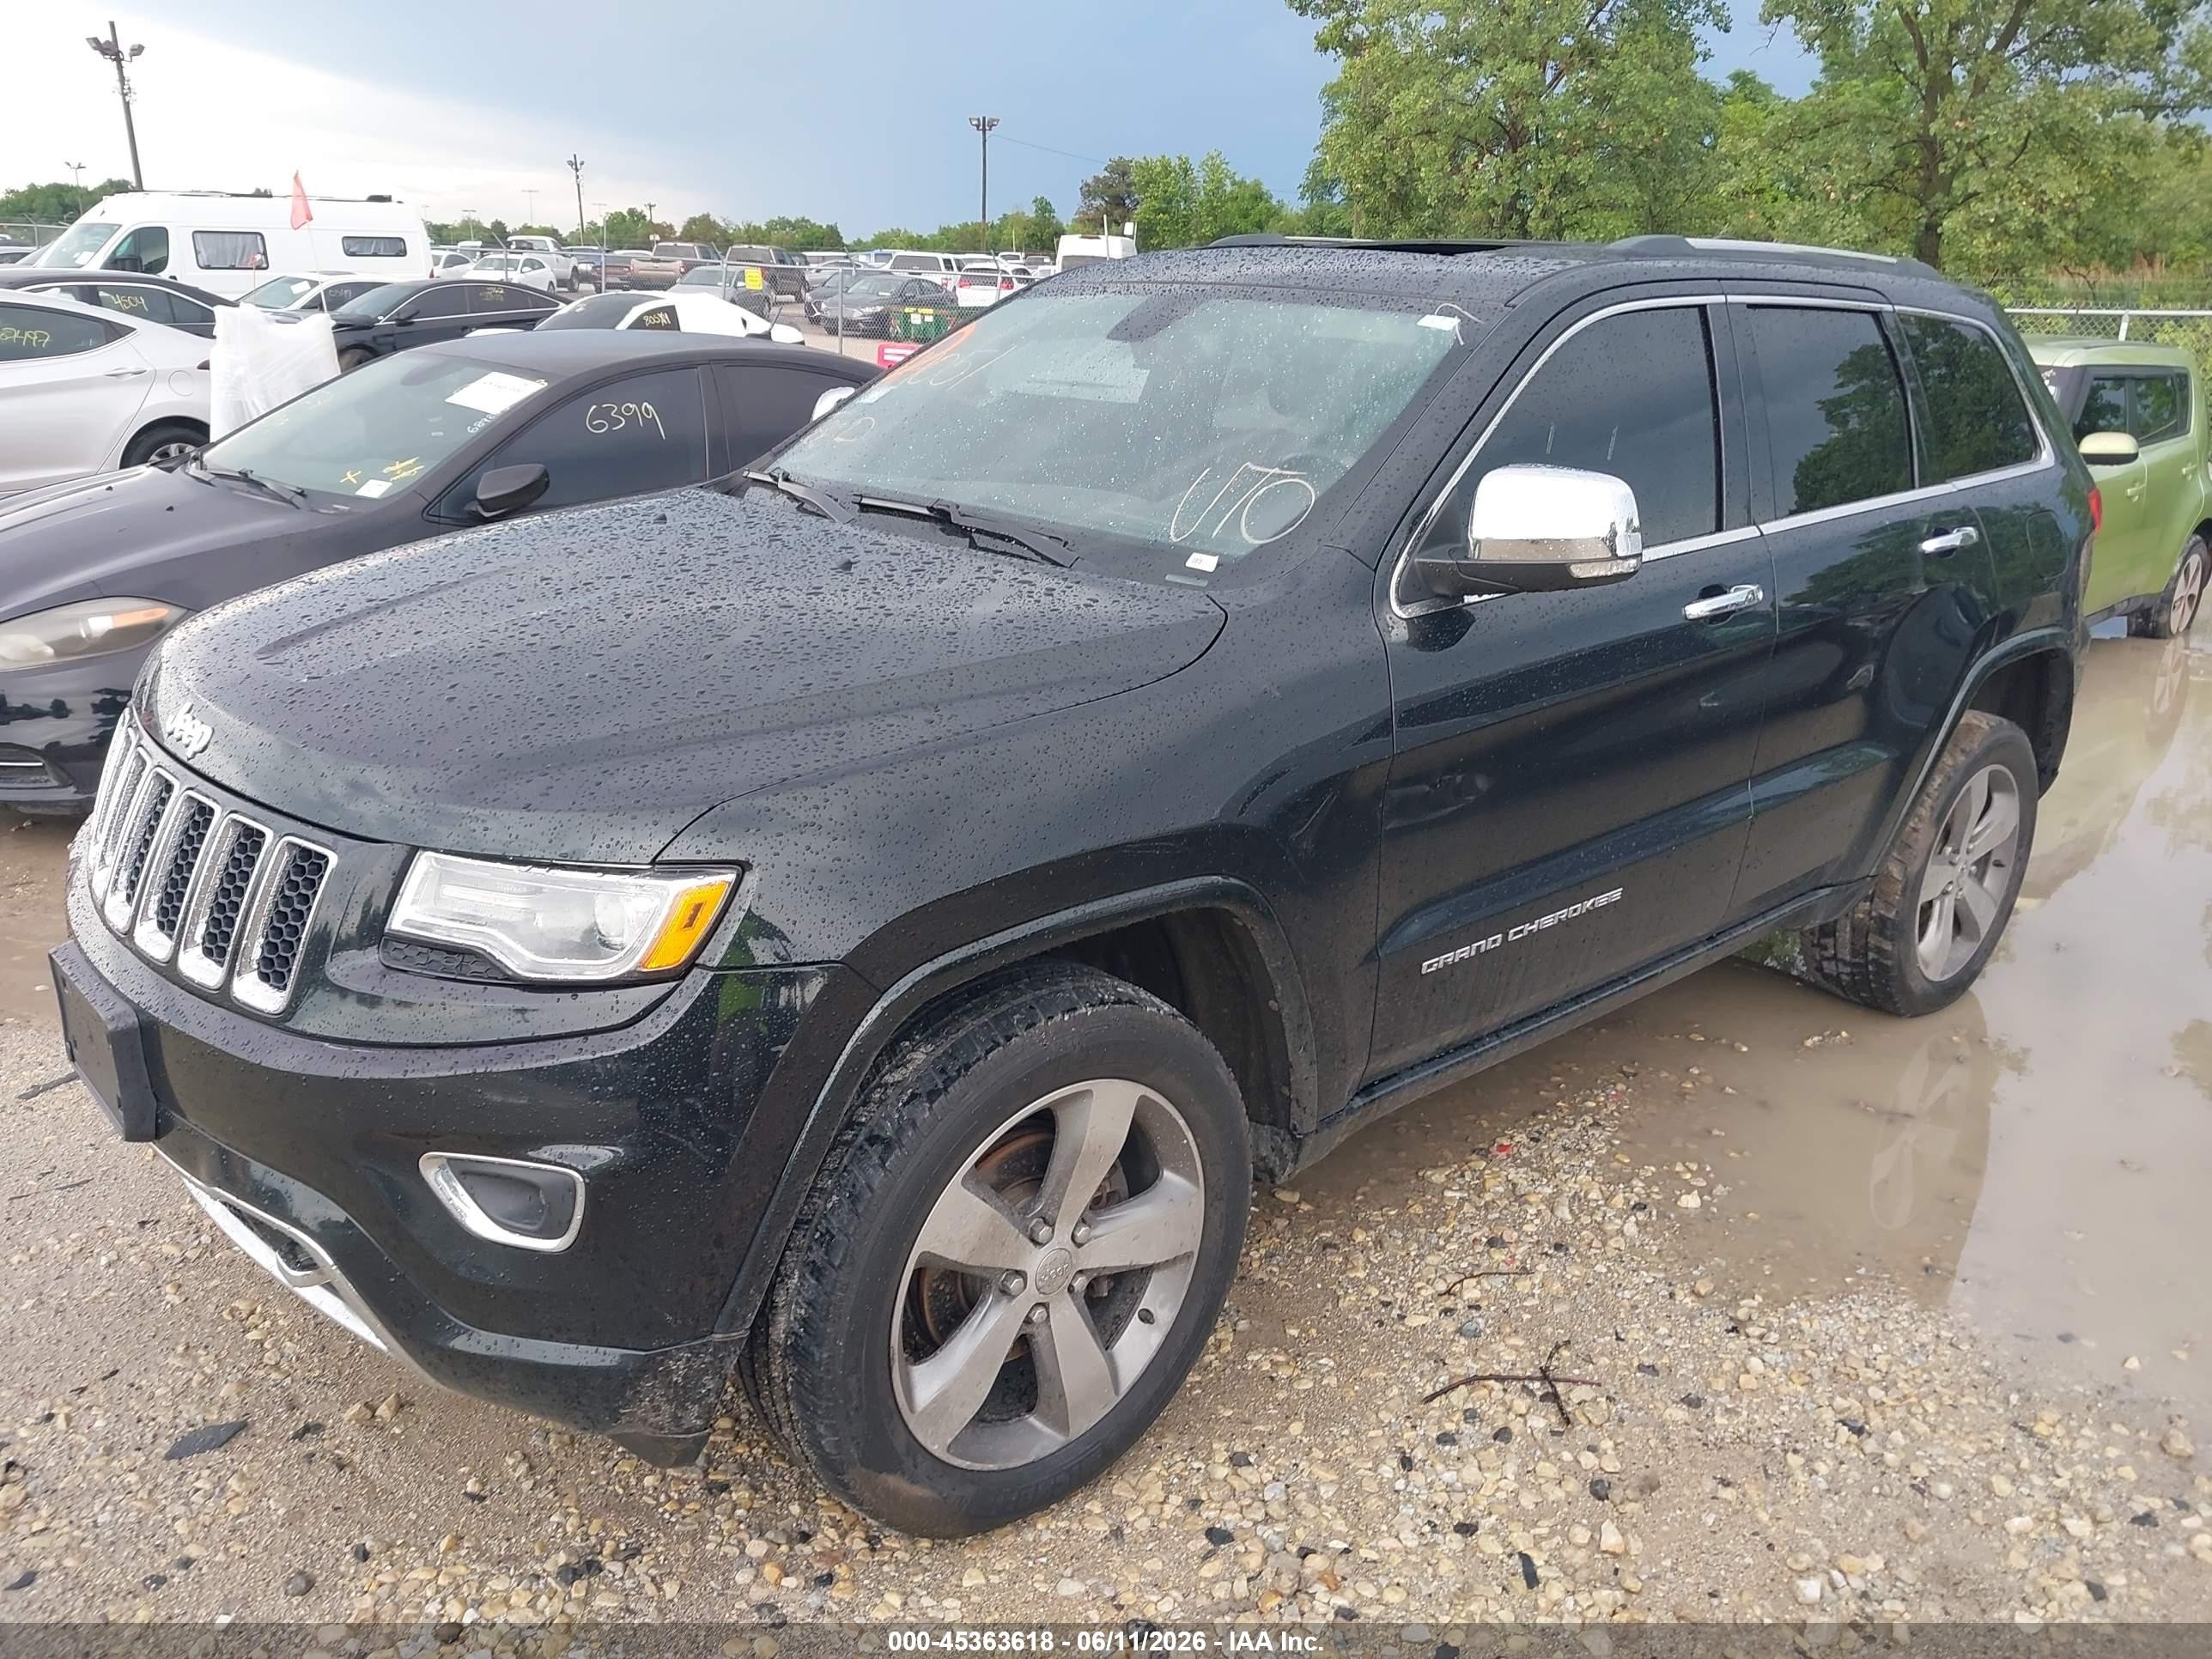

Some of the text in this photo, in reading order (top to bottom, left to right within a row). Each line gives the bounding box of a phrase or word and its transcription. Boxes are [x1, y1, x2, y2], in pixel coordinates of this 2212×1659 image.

[111, 293, 149, 312] 4504
[585, 401, 666, 441] 6399
[1419, 886, 1625, 975] GRAND CHEROKEE
